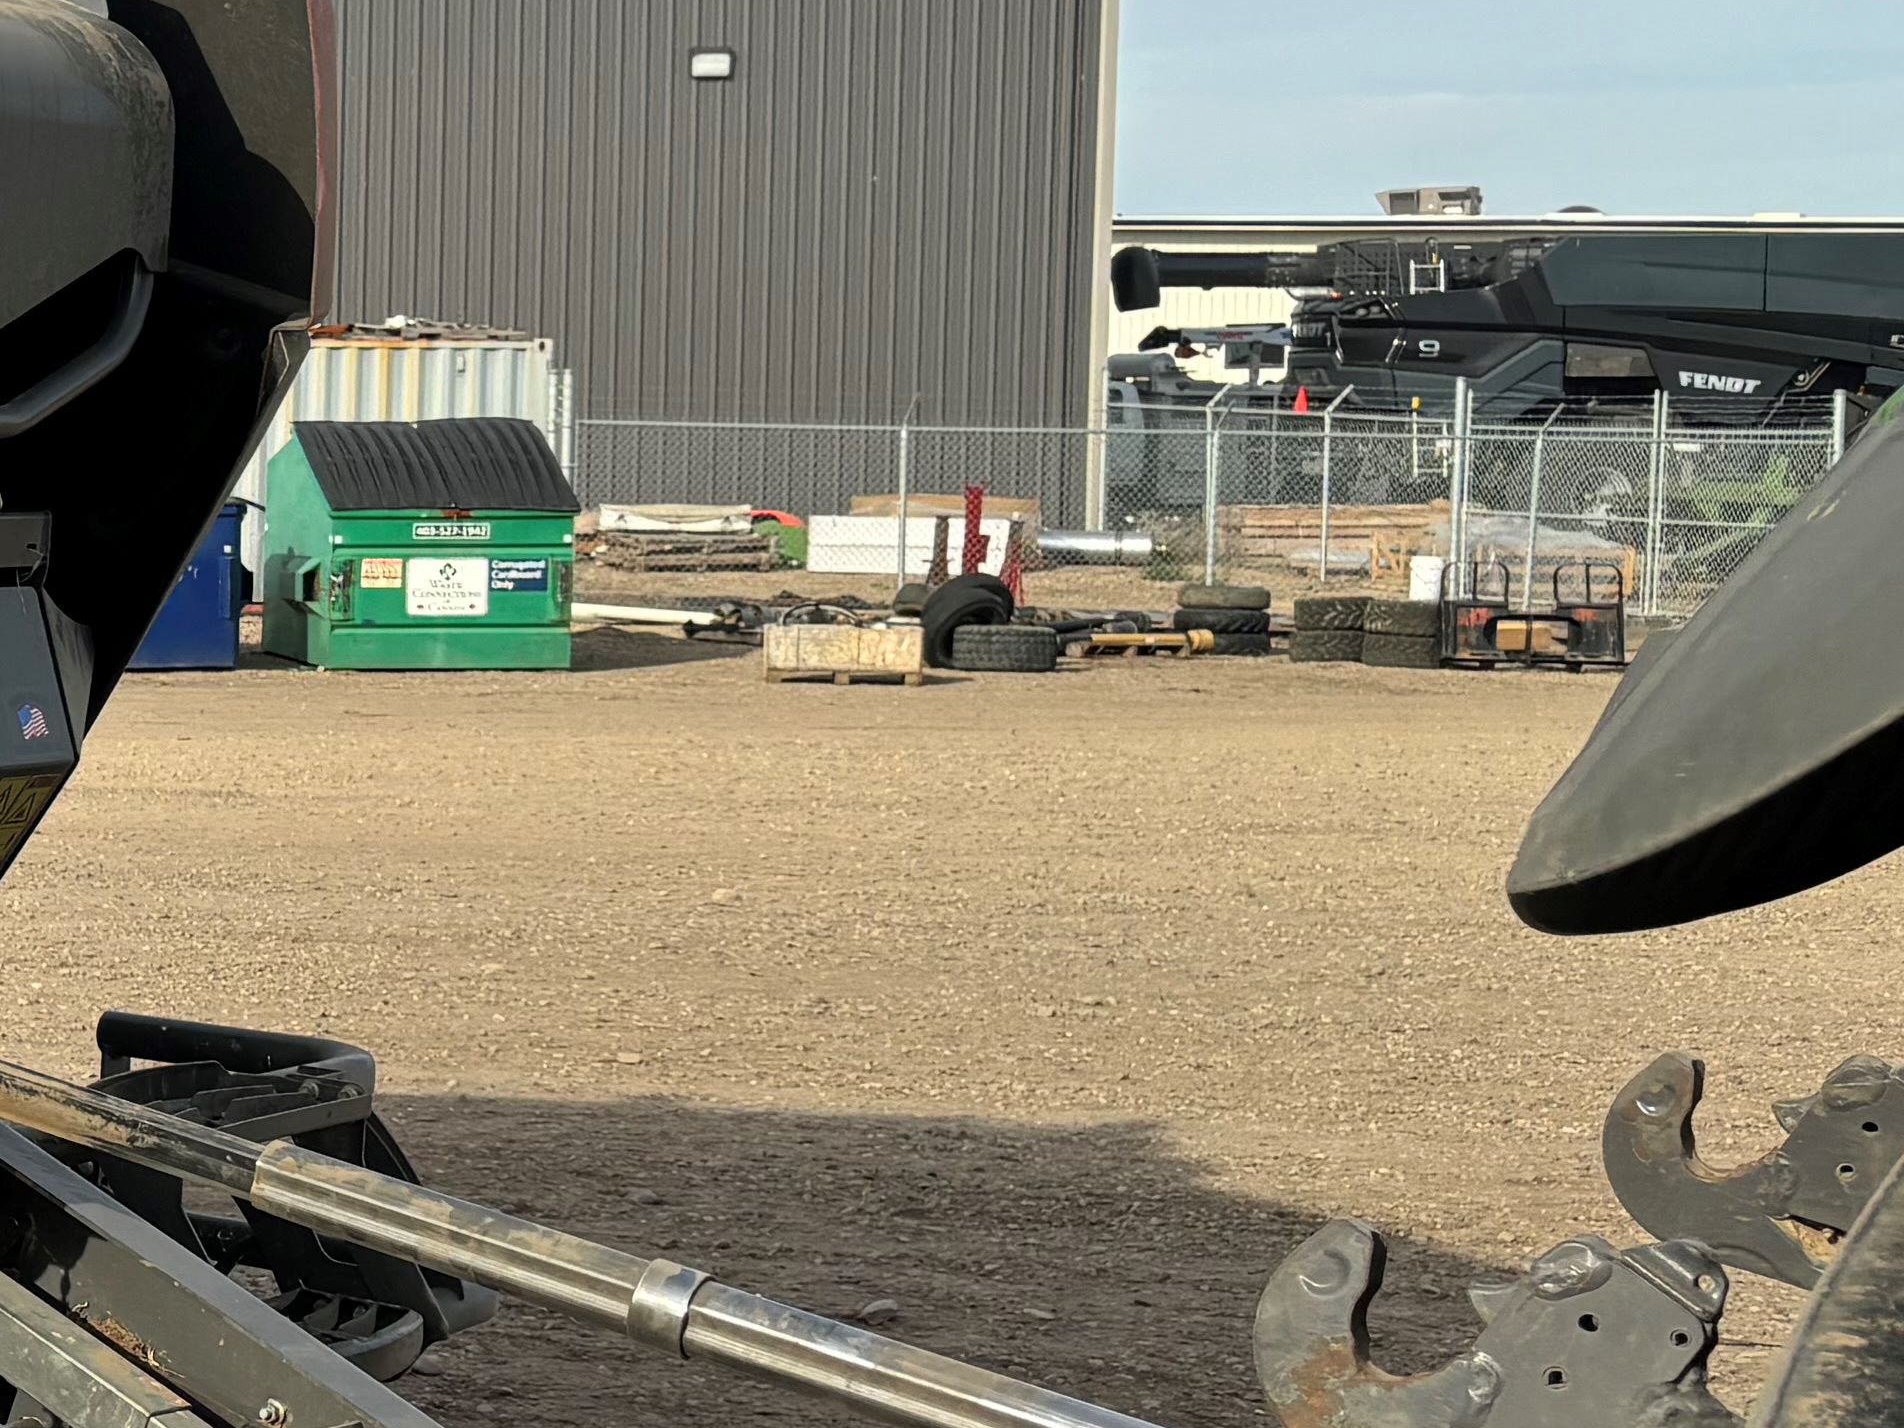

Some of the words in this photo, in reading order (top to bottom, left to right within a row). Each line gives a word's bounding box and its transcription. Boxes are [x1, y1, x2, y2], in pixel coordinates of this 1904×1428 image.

[1418, 339, 1440, 358] 9
[1678, 371, 1762, 394] FENDT
[491, 569, 543, 579] Cardboard
[491, 579, 514, 590] Only
